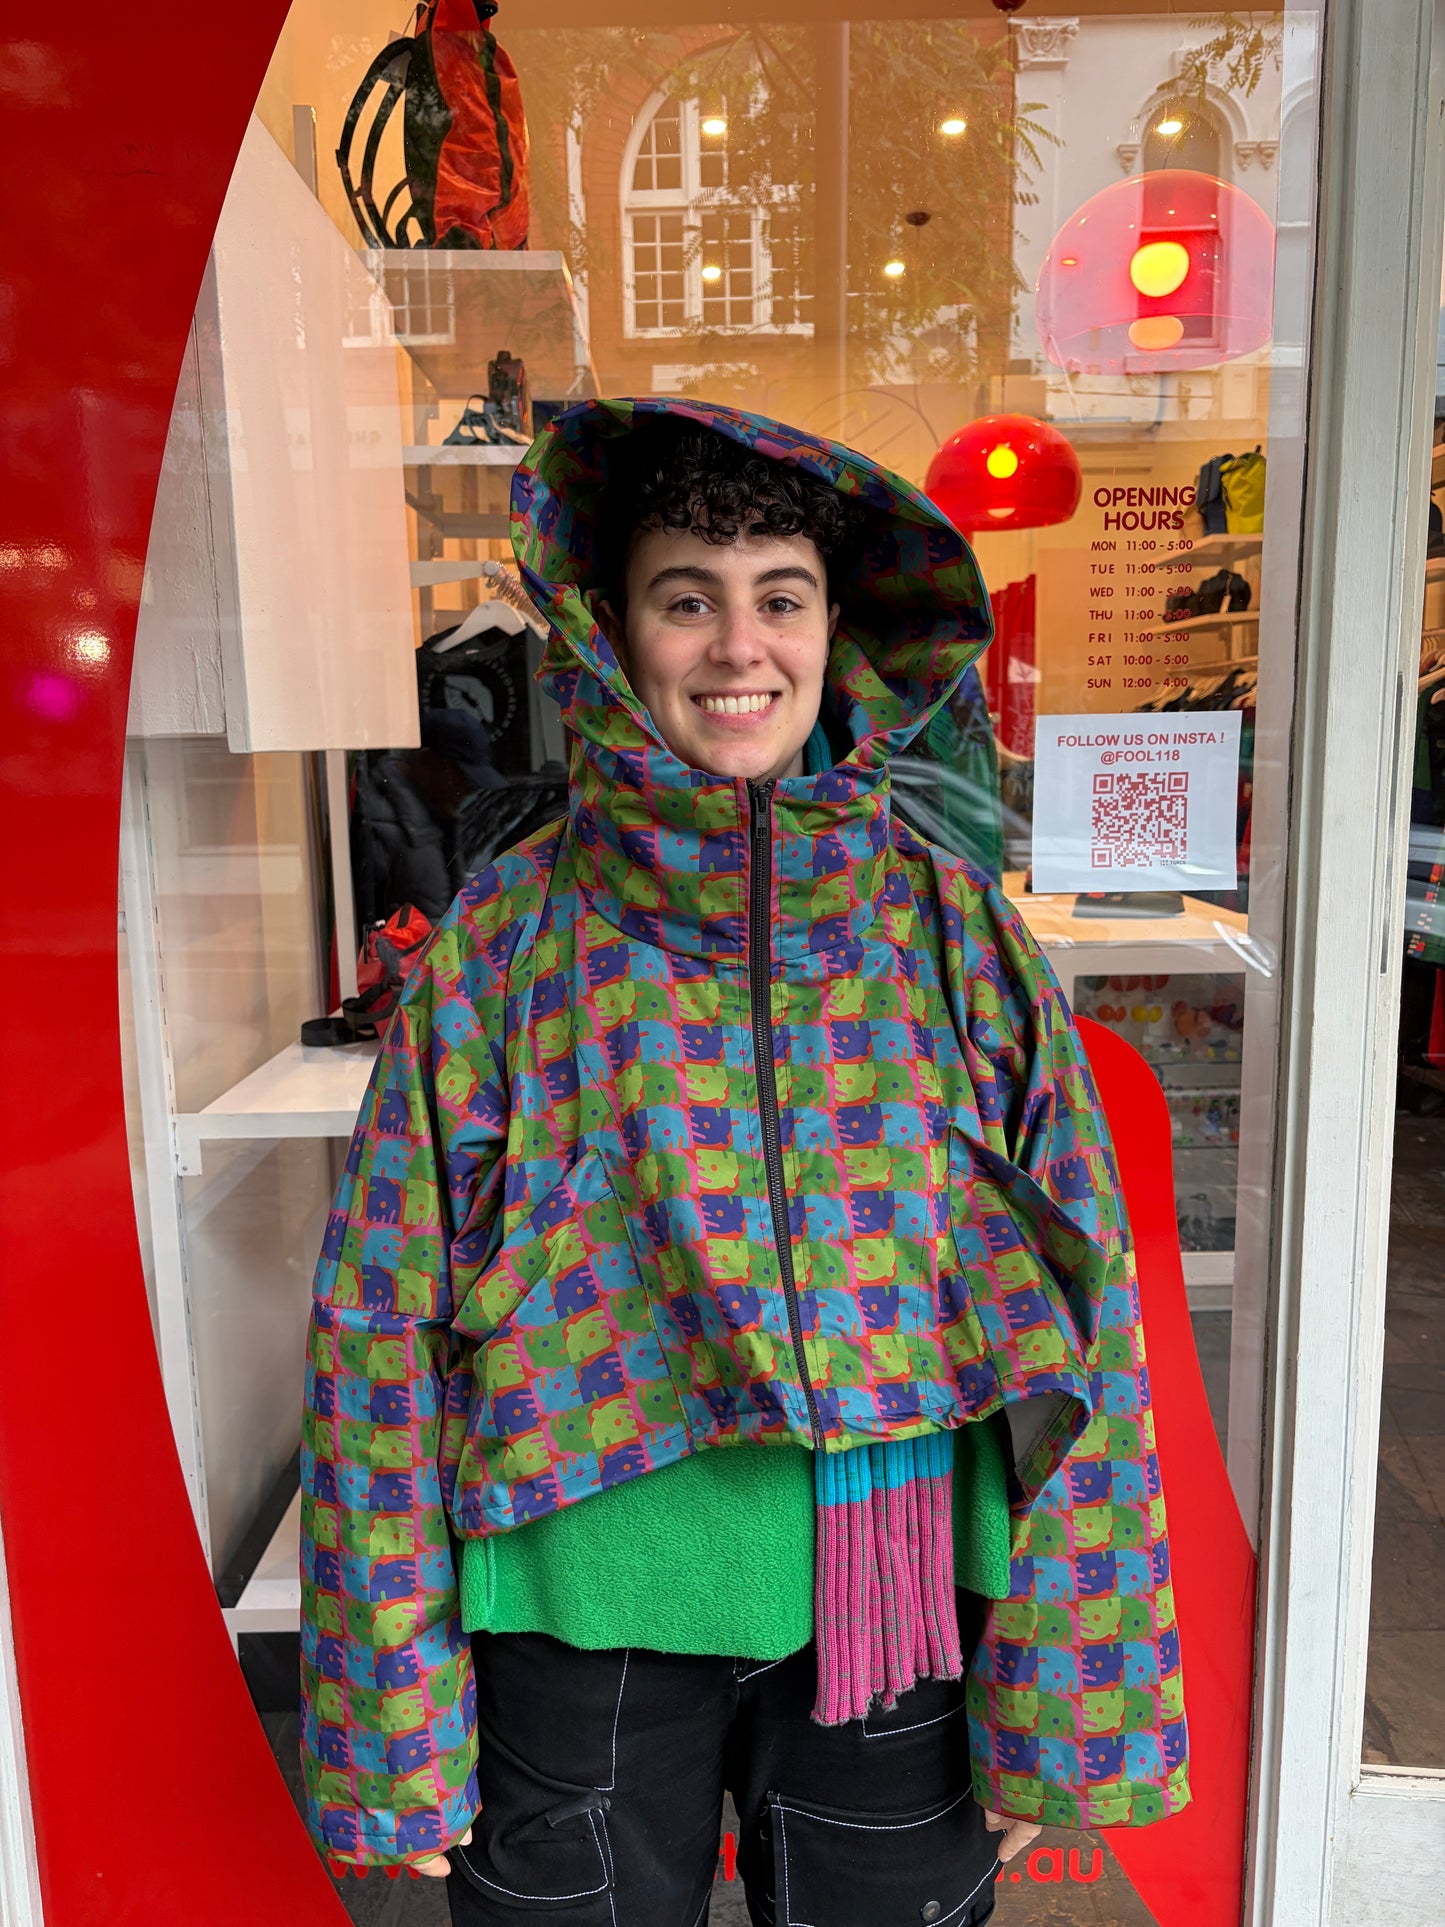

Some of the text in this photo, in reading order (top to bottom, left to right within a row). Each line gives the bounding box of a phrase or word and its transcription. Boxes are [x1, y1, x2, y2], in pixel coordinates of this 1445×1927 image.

[1093, 486, 1197, 508] OPENING
[1104, 510, 1185, 531] HOURS
[1091, 541, 1117, 551] MON
[1126, 540, 1157, 551] 11:00
[1167, 540, 1194, 551] 5:00
[1090, 564, 1115, 575] TUE
[1126, 563, 1156, 574] 11:00
[1166, 563, 1192, 575] 5:00
[1090, 586, 1114, 598] WED
[1125, 586, 1155, 597] 11:00
[1165, 586, 1192, 598] 5:00
[1088, 610, 1113, 621] THU
[1124, 609, 1154, 620] 11:00
[1088, 632, 1112, 643] FRI
[1123, 632, 1153, 643] 11:00
[1163, 632, 1190, 643] 5:00
[1088, 655, 1112, 666] SAT
[1123, 655, 1153, 666] 10:00
[1163, 655, 1189, 665] 5:00
[1087, 678, 1111, 689] SUN
[1122, 678, 1152, 688] 12:00
[1163, 677, 1188, 688] 4:00
[1057, 734, 1120, 748] FOLLOW
[1123, 734, 1144, 746] US
[1147, 733, 1169, 745] ON
[1173, 732, 1217, 744] INSTA
[1100, 750, 1180, 766] @FOOL118
